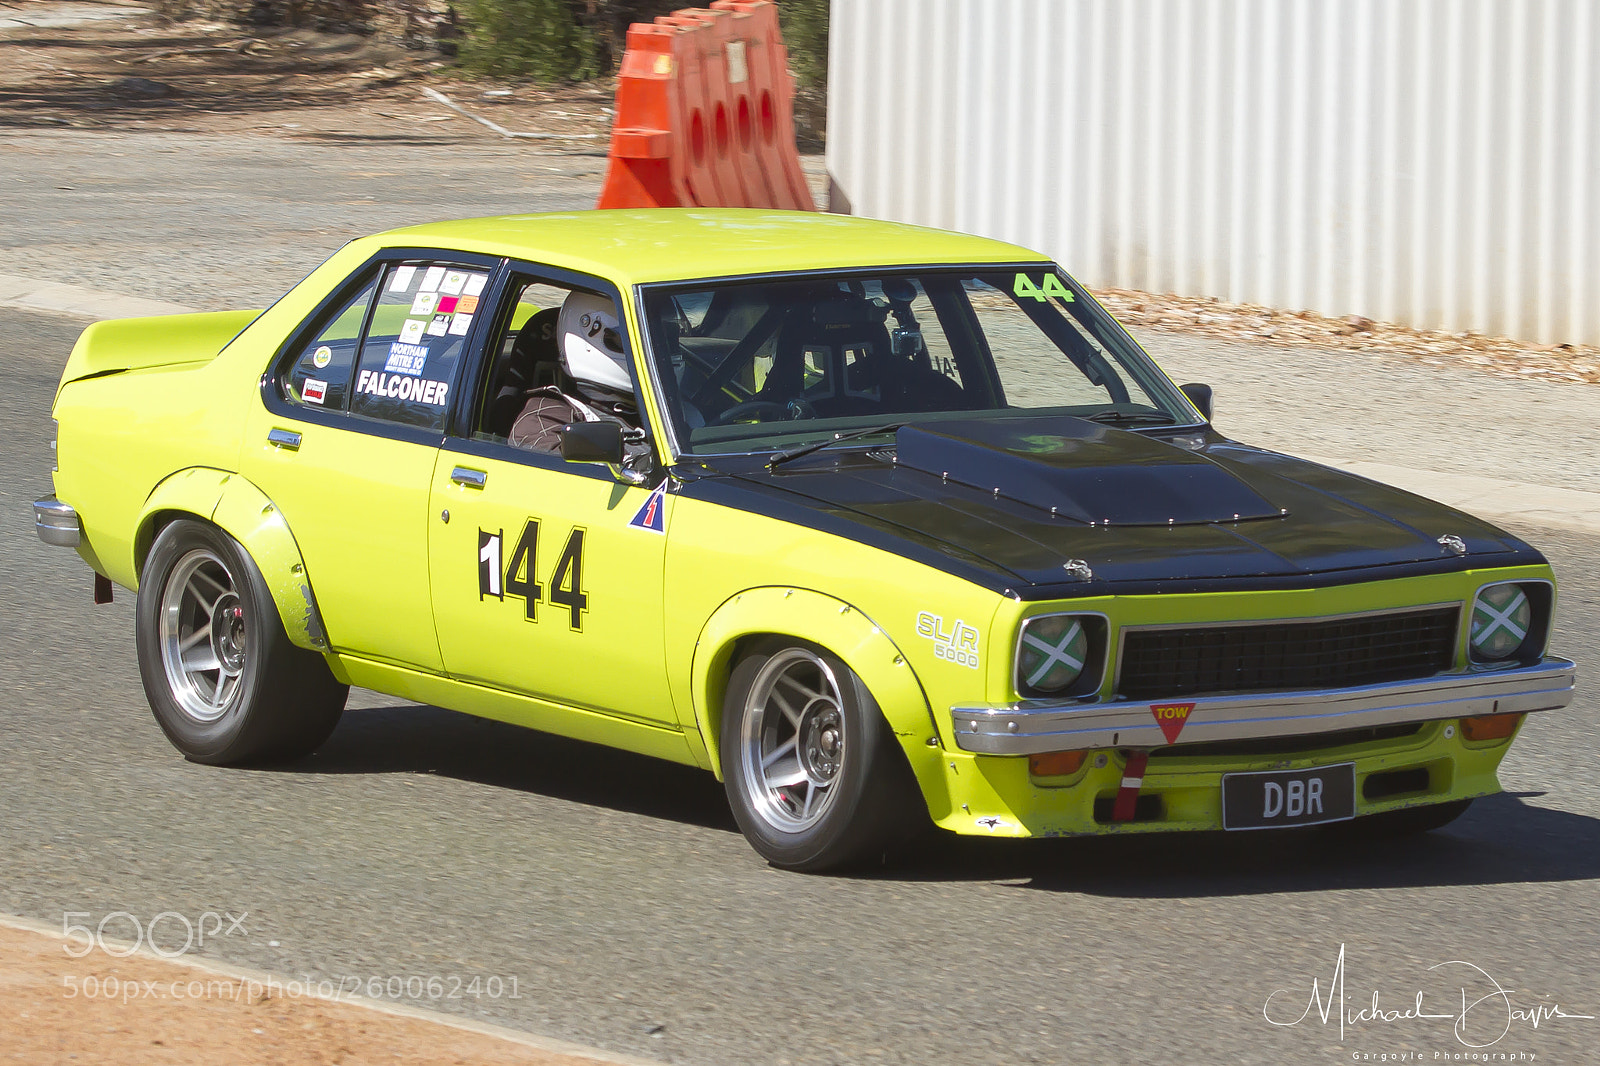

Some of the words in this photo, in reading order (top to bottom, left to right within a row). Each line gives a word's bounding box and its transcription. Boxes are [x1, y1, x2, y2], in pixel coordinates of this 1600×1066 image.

[1013, 273, 1075, 302] 44
[387, 354, 413, 368] MITRE
[413, 357, 424, 369] 10
[391, 343, 428, 357] NORTHAM
[356, 370, 448, 406] FALCONER
[479, 516, 589, 634] 144
[916, 610, 979, 653] SL/R
[934, 643, 979, 669] 5000
[1156, 706, 1189, 719] TOW
[1263, 778, 1324, 818] DBR
